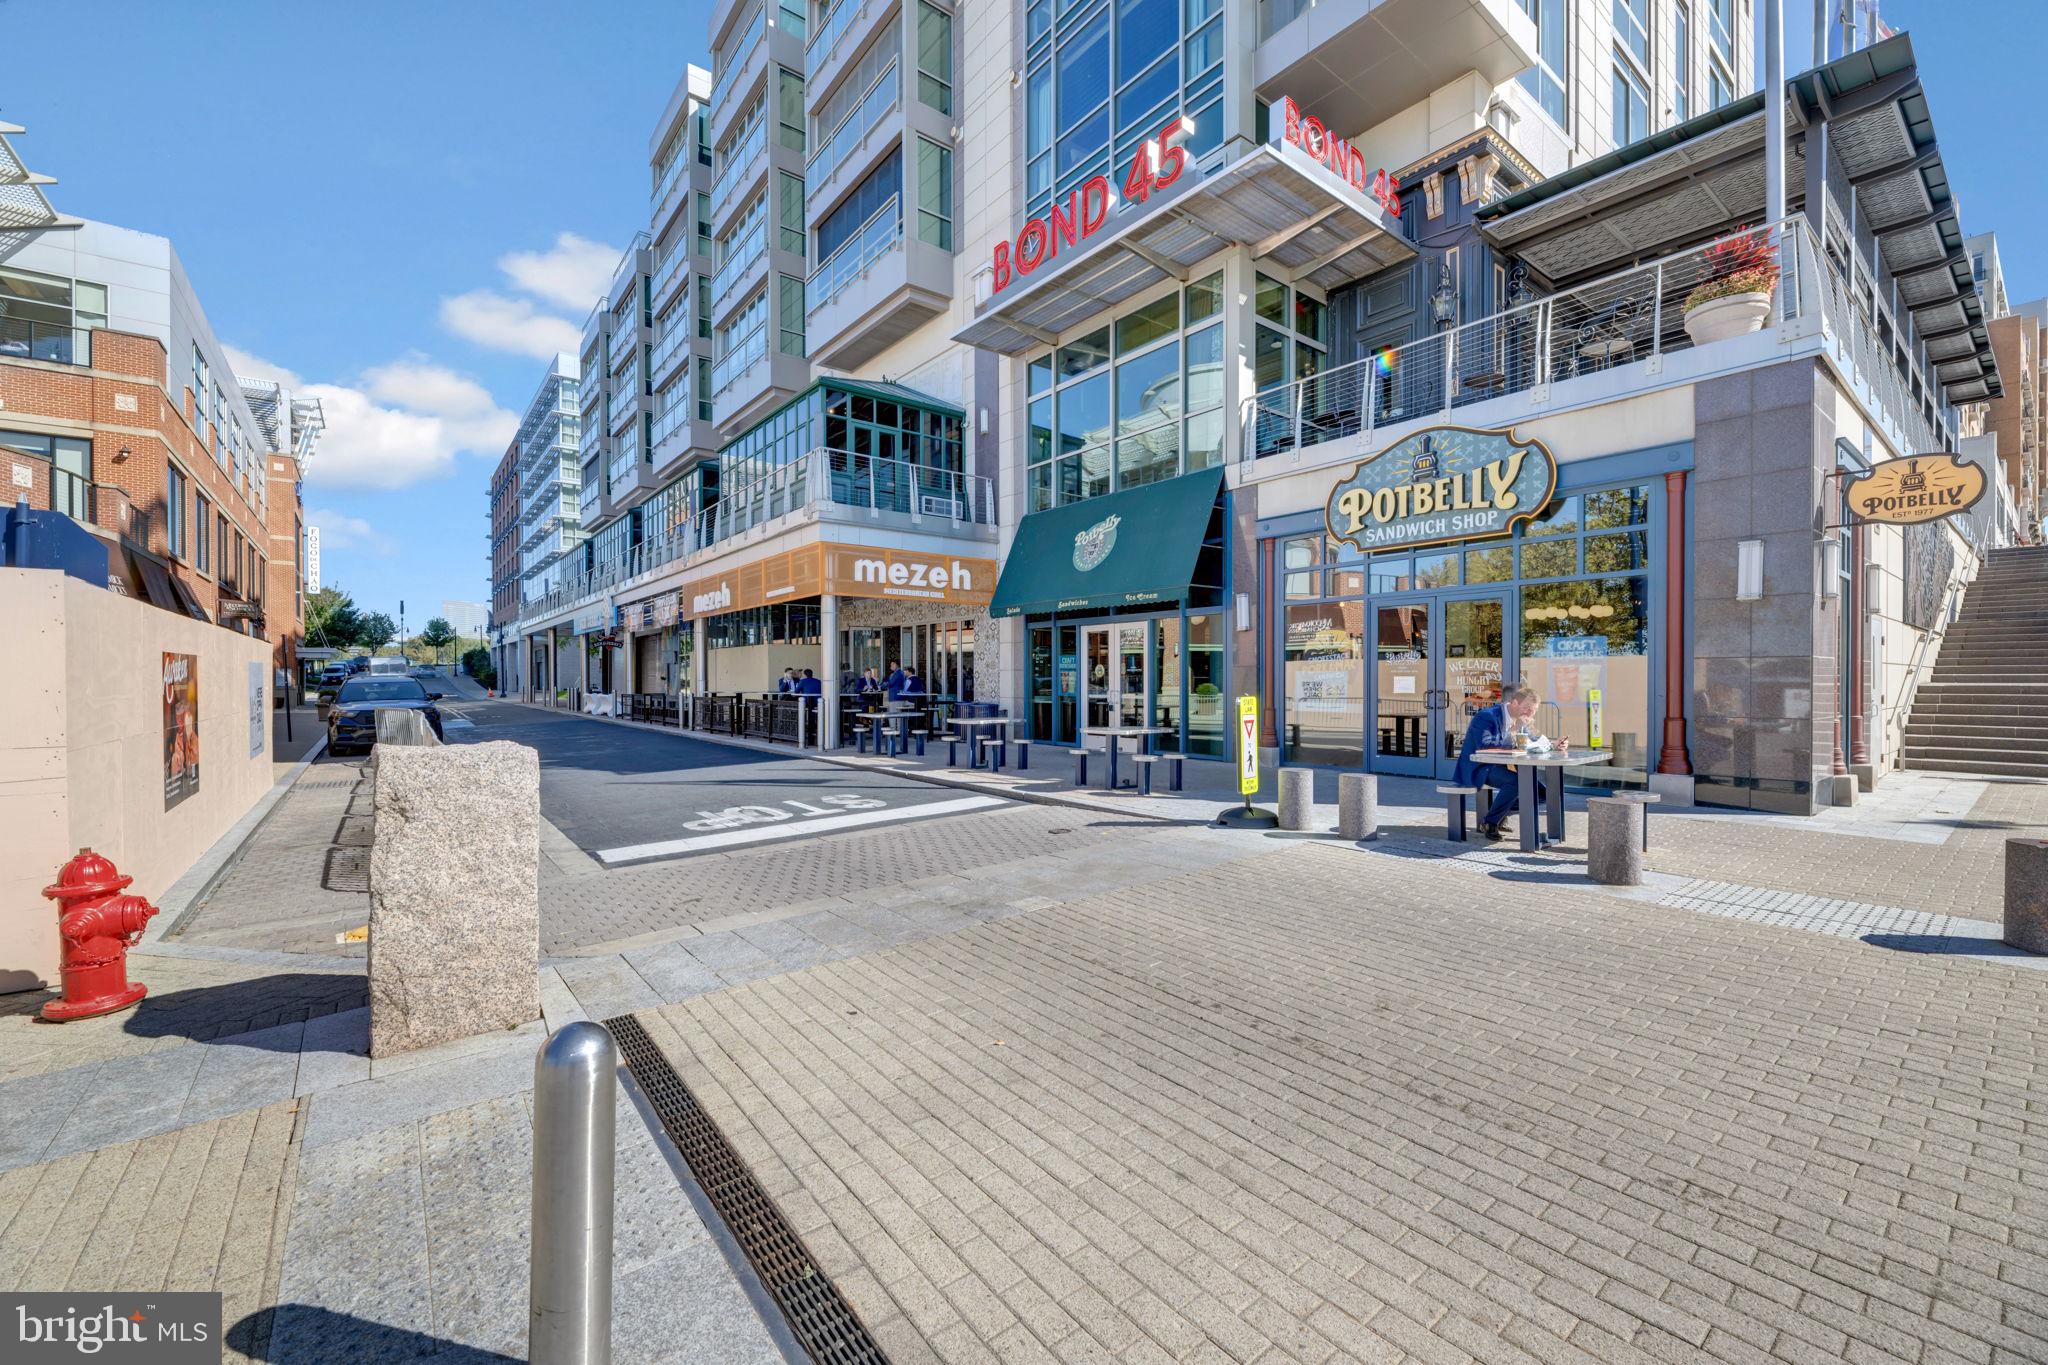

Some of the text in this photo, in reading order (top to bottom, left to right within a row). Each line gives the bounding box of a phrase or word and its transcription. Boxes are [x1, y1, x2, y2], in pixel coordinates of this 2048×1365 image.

[1285, 95, 1401, 217] BOND 45
[994, 115, 1195, 294] BOND 45
[1338, 449, 1528, 535] POTBELLY
[1862, 483, 1967, 516] POTBELLY
[1366, 510, 1498, 543] SANDWICH SHOP
[1914, 508, 1934, 516] 1977
[854, 558, 972, 591] mezeh
[693, 581, 731, 614] mezeh
[1058, 600, 1089, 608] Sandwiches
[1557, 640, 1598, 651] CRAFT
[1449, 660, 1499, 673] WE CATER
[1462, 685, 1485, 693] GROUP
[682, 794, 887, 830] STOP
